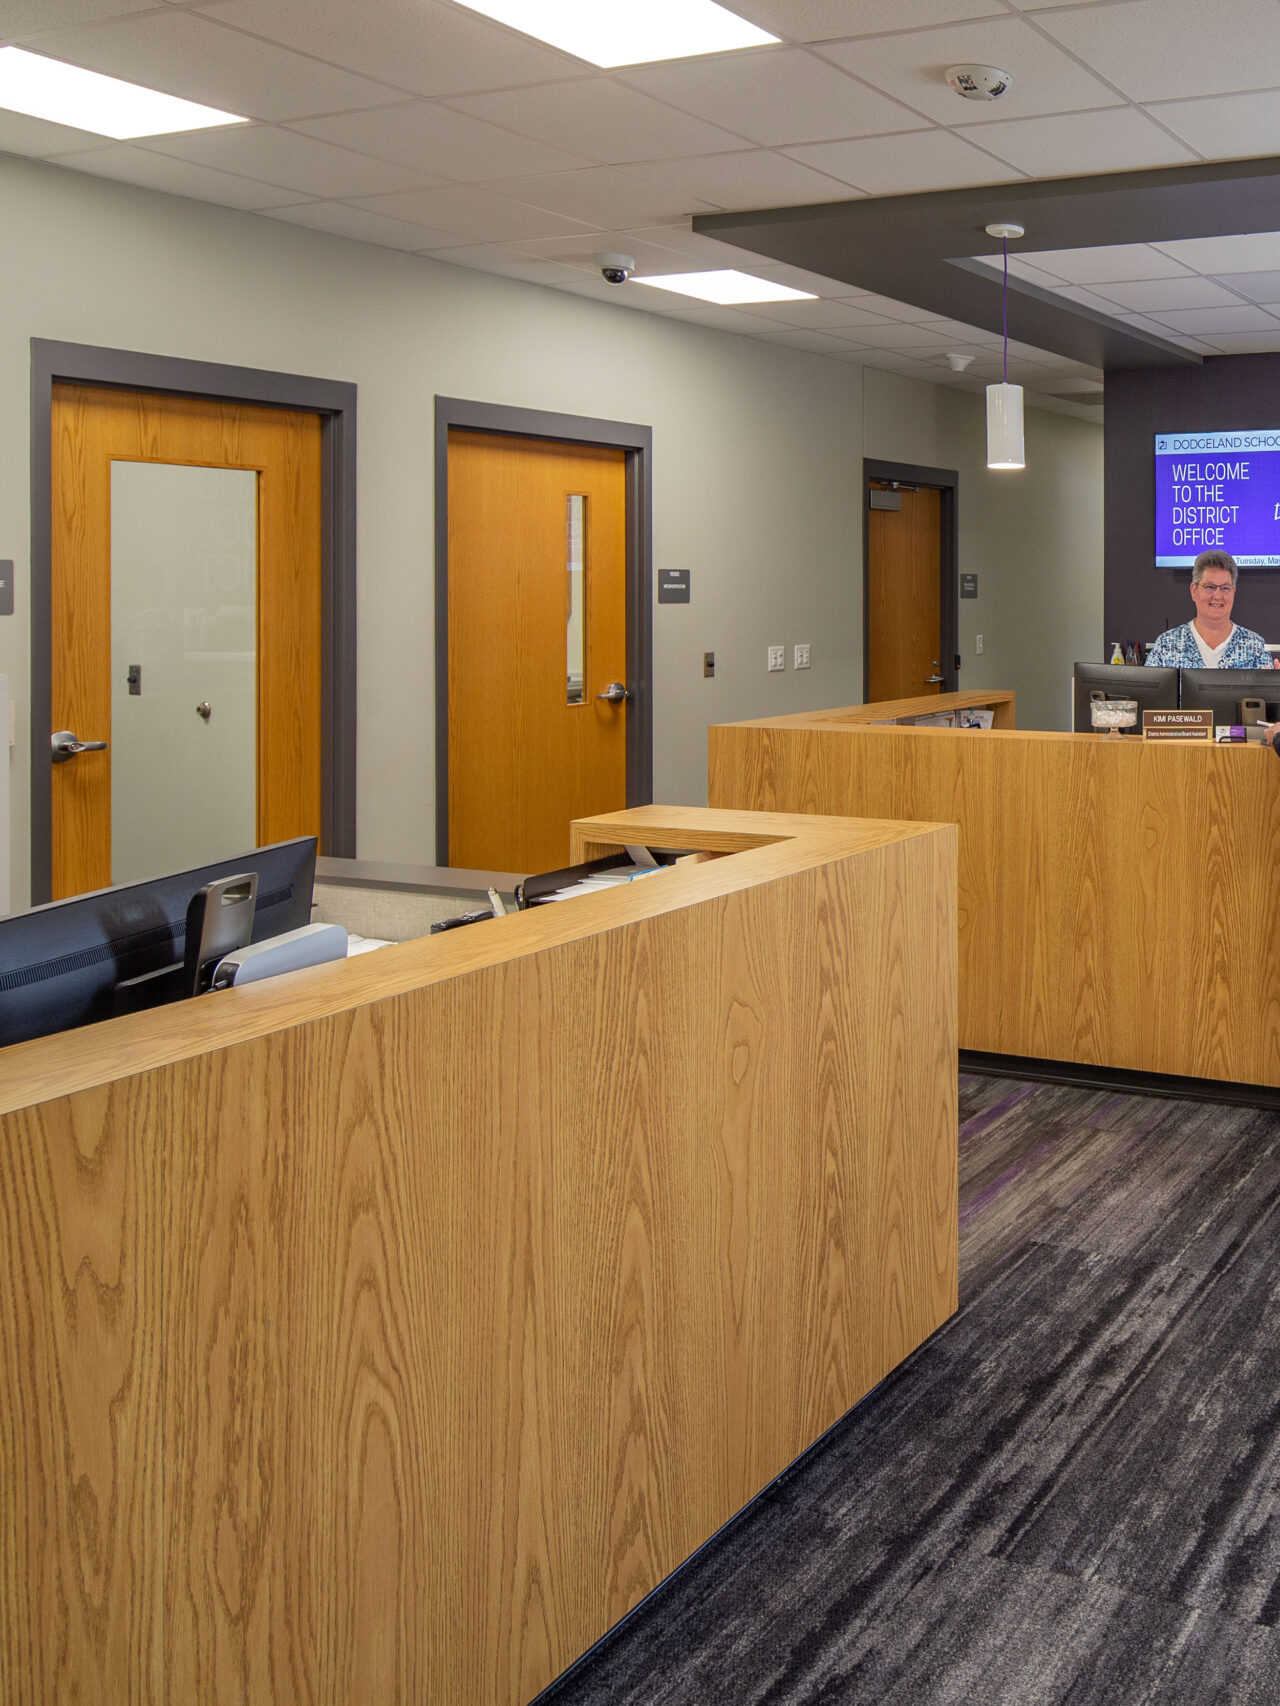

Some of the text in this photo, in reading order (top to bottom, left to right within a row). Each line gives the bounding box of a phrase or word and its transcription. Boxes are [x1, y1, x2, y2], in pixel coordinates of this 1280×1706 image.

[1173, 437, 1242, 450] DODGELAND
[1172, 462, 1250, 481] WELCOME
[1172, 484, 1224, 503] TO THE
[1173, 506, 1239, 524] DISTRICT
[1173, 528, 1224, 545] OFFICE
[1236, 557, 1265, 567] Tuesday,
